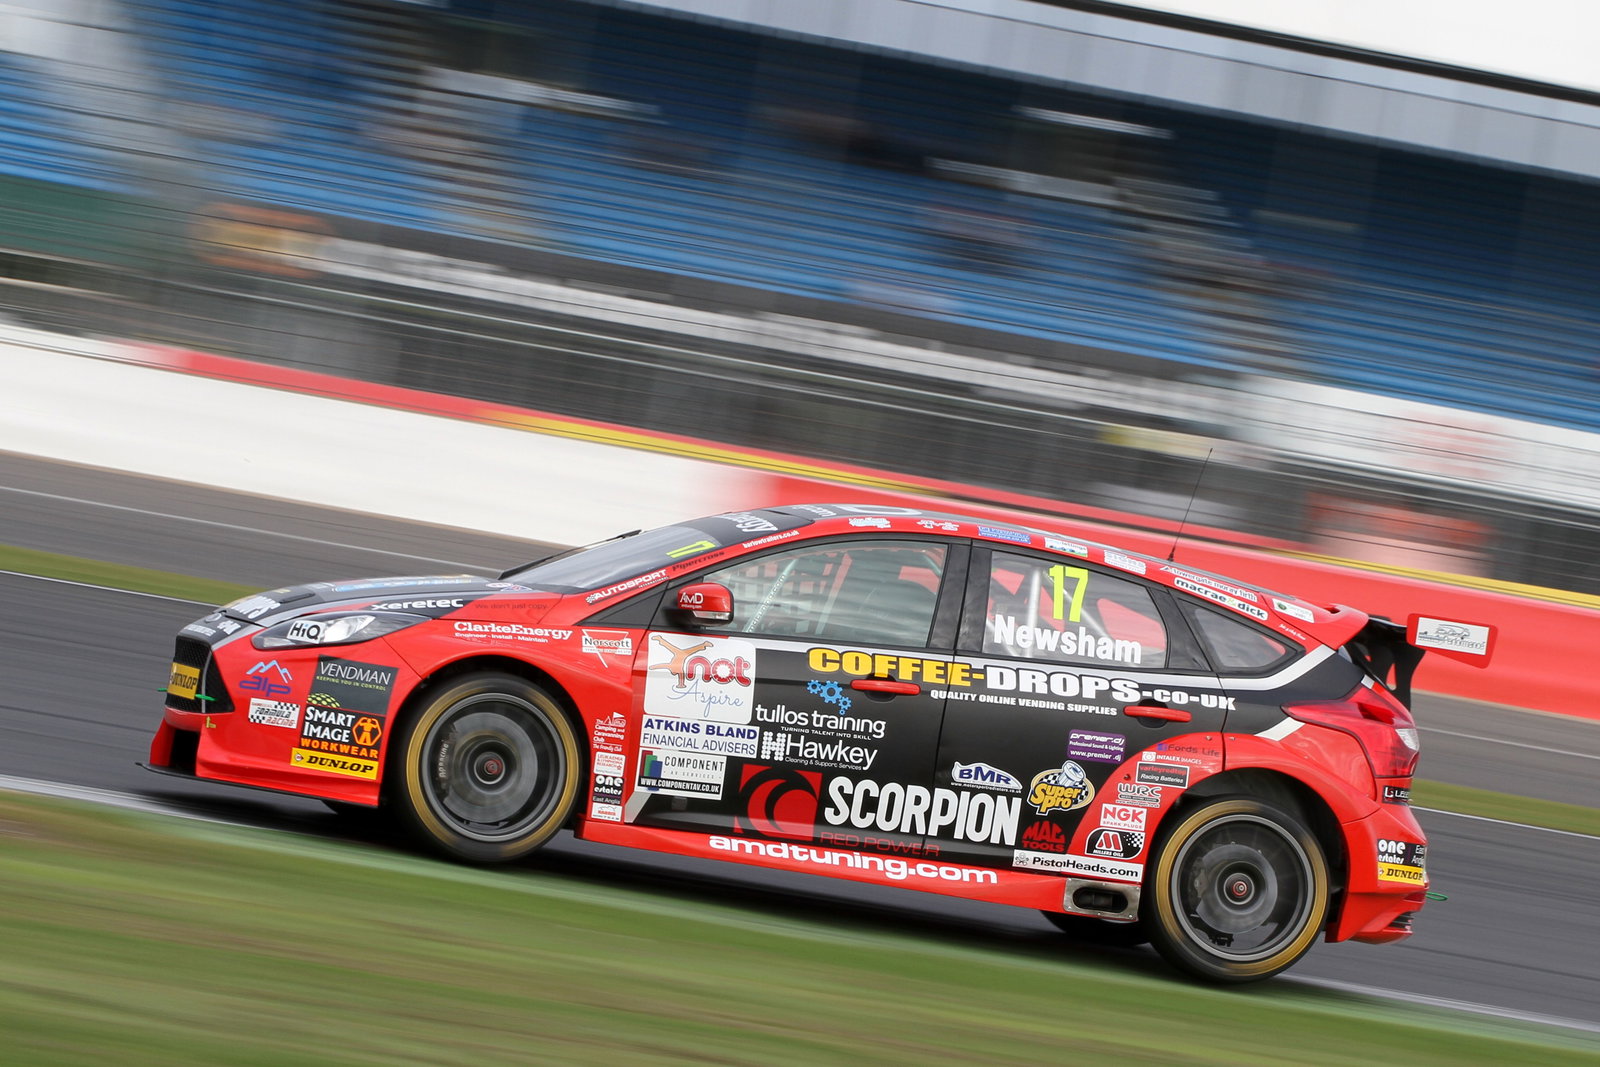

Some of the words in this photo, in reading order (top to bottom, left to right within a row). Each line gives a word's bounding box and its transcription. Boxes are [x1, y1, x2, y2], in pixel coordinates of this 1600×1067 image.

[672, 551, 725, 571] Pipercross
[595, 569, 667, 600] AUTOSPORT
[1049, 564, 1089, 623] 17
[371, 598, 464, 610] xeretec
[1237, 602, 1266, 619] dick
[289, 621, 321, 641] HiQ
[994, 614, 1142, 664] Newsham
[316, 675, 340, 685] KEEPING
[320, 661, 391, 685] VENDMAN
[666, 679, 744, 718] Aspire
[930, 689, 977, 702] QUALITY
[979, 694, 1016, 706] ONLINE
[1018, 699, 1065, 711] VENDING
[1067, 703, 1117, 716] SUPPLIES
[255, 707, 292, 718] FORMULA
[305, 707, 355, 727] SMART
[755, 704, 809, 725] tullos
[812, 710, 887, 739] training
[303, 723, 351, 743] IMAGE
[644, 718, 701, 734] ATKINS
[705, 724, 758, 740] BLAND
[781, 726, 810, 734] TURNING
[811, 729, 834, 737] TALENT
[301, 737, 379, 759] WORKWEAR
[642, 733, 699, 749] FINANCIAL
[702, 740, 756, 755] ADVISERS
[1070, 733, 1125, 746] premier.dj
[1168, 744, 1198, 754] Fords
[307, 755, 374, 773] DUNLOP
[664, 755, 725, 772] COMPONENT
[785, 756, 808, 766] Cleaning
[838, 763, 862, 771] Services
[595, 775, 624, 787] one
[640, 777, 719, 793] WWW.COMPONENTAV.CO.UK
[959, 766, 1012, 785] BMR
[1160, 776, 1184, 784] Batteries
[594, 785, 622, 796] estates
[1030, 782, 1081, 801] Super
[1119, 783, 1162, 797] WRC
[824, 776, 1022, 846] SCORPION
[1103, 806, 1144, 823] NGK
[1022, 821, 1066, 843] MAC
[820, 831, 861, 847] RED
[863, 836, 942, 857] POWER
[1022, 841, 1065, 852] TOOLS
[1378, 839, 1406, 855] one
[709, 834, 998, 884] amdtuning.com
[1378, 854, 1405, 864] estates
